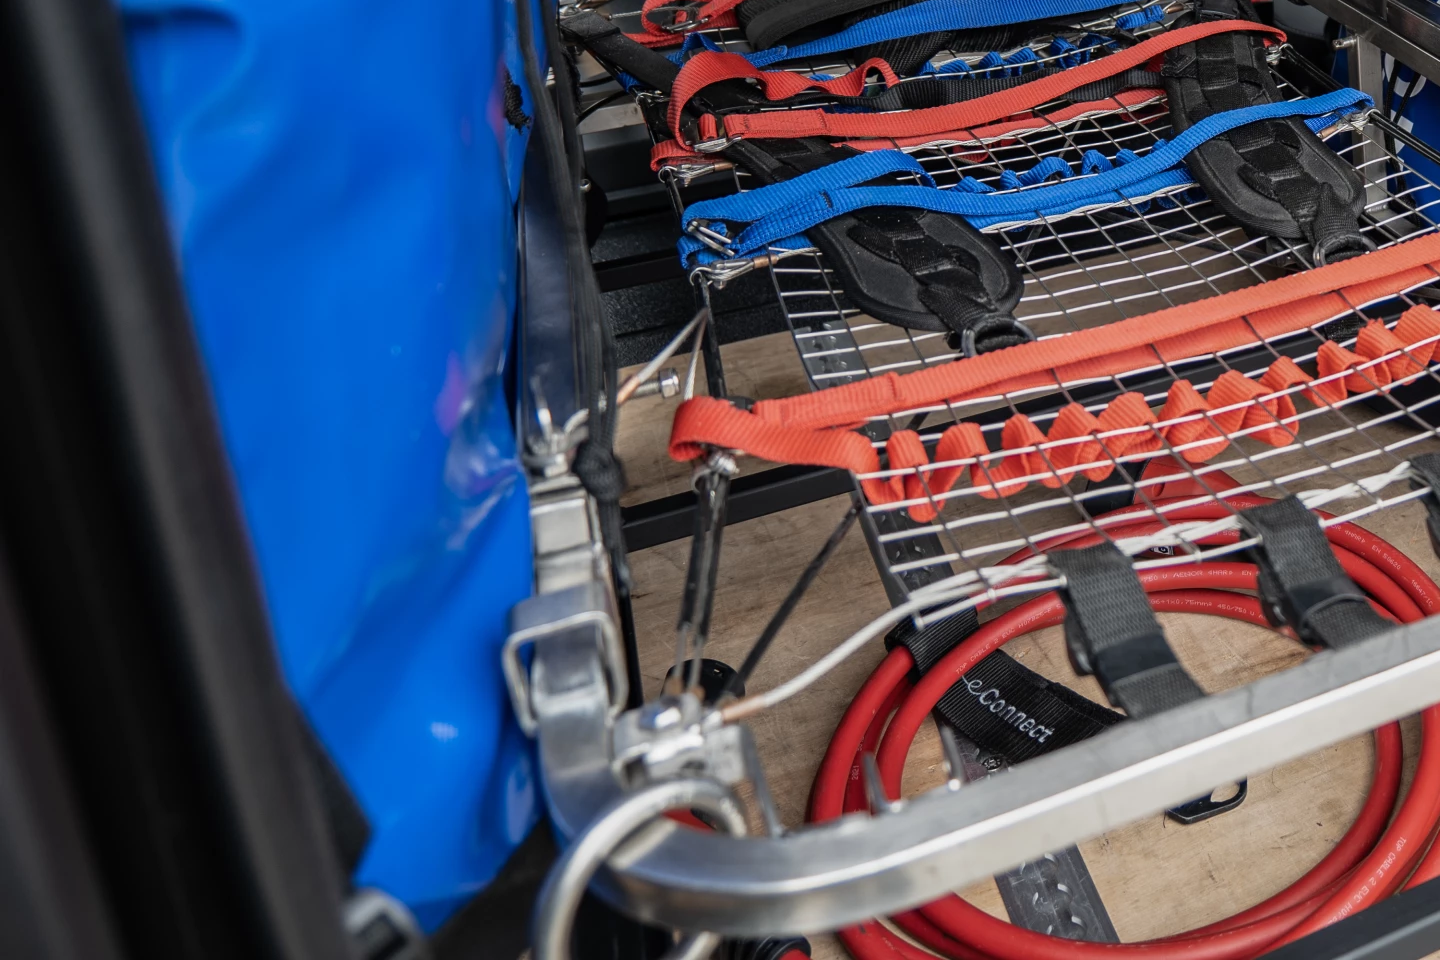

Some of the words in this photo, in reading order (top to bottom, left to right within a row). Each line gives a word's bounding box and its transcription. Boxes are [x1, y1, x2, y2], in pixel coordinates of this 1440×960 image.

[1371, 544, 1382, 554] EN
[1382, 553, 1402, 571] 50620
[1172, 569, 1204, 579] AENOR
[1217, 602, 1247, 615] 450/750
[955, 662, 968, 675] TOP
[969, 643, 991, 663] CABLE
[962, 675, 1056, 744] eConnect
[1395, 836, 1407, 852] TOP
[1376, 852, 1396, 878] CABLE
[1368, 877, 1377, 886] 2
